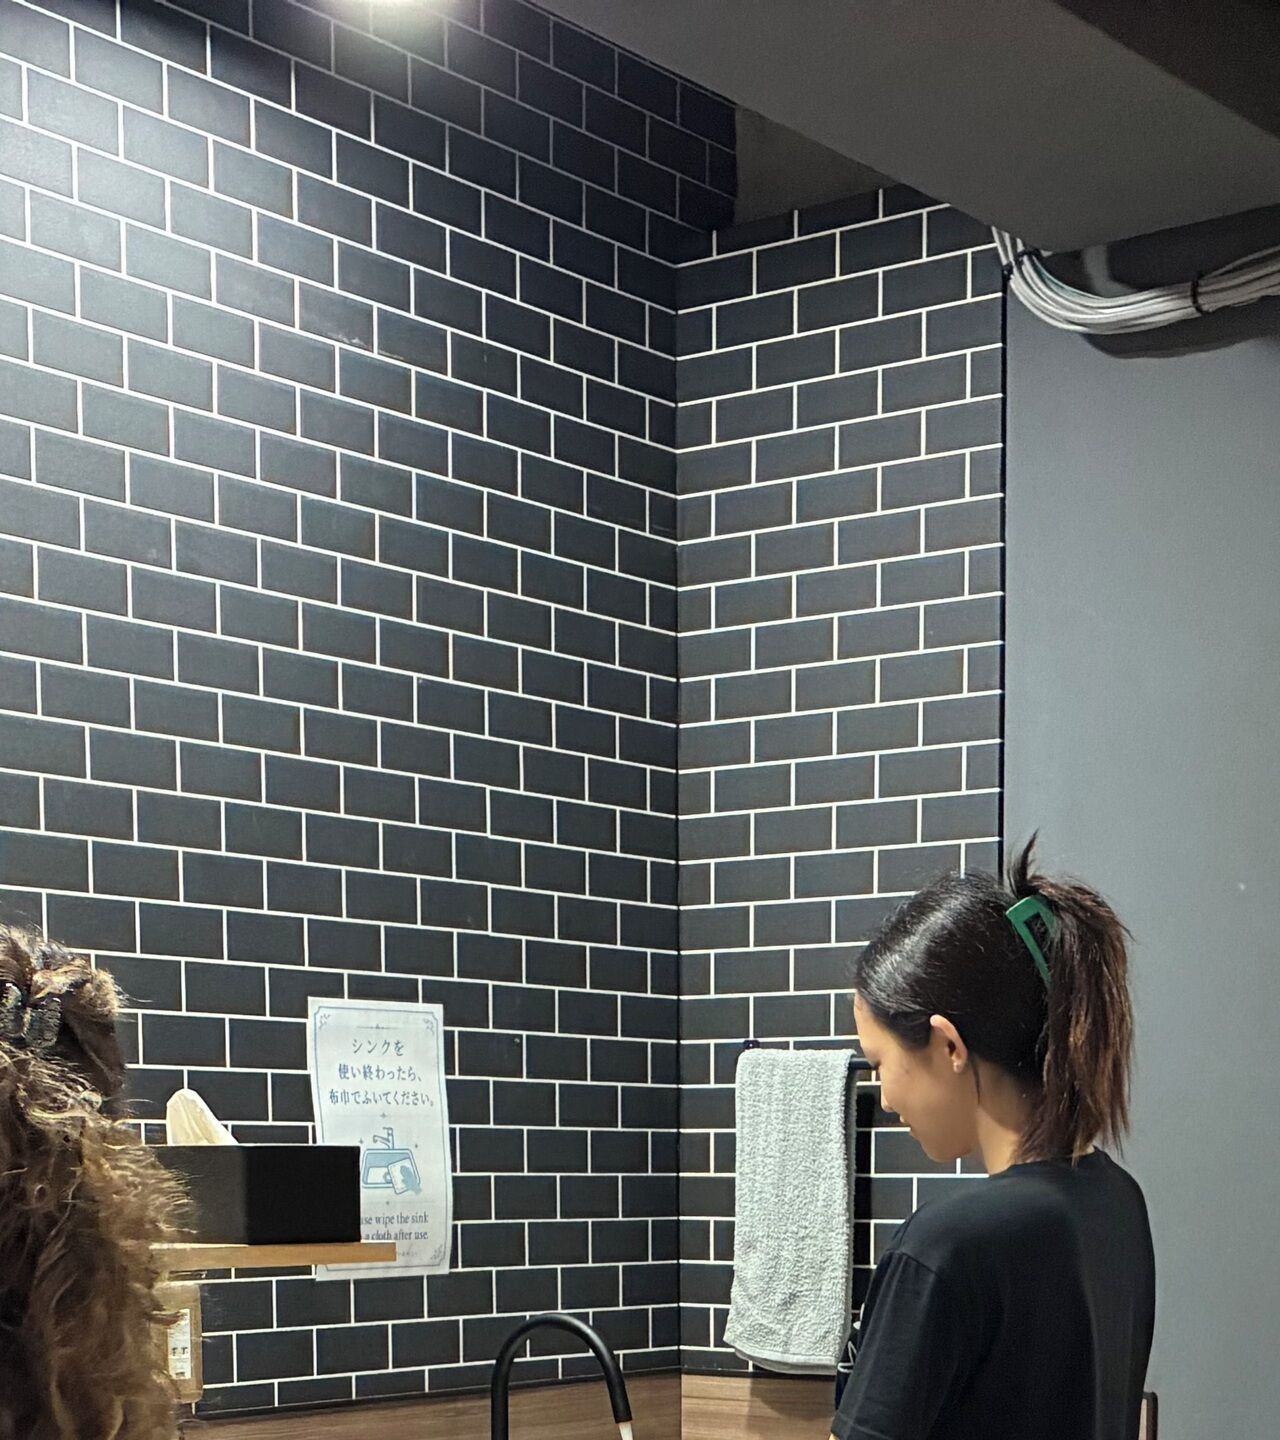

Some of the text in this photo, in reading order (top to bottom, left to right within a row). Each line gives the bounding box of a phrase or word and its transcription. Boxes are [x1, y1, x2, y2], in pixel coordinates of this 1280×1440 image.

[352, 1039, 404, 1056] シンクを
[338, 1063, 422, 1082] 使い終わったら、
[329, 1088, 434, 1107] 布巾でふいてください。
[375, 1213, 395, 1228] wipe
[397, 1211, 410, 1224] the
[411, 1211, 429, 1224] sink
[371, 1229, 392, 1241] cloth
[393, 1229, 412, 1241] after
